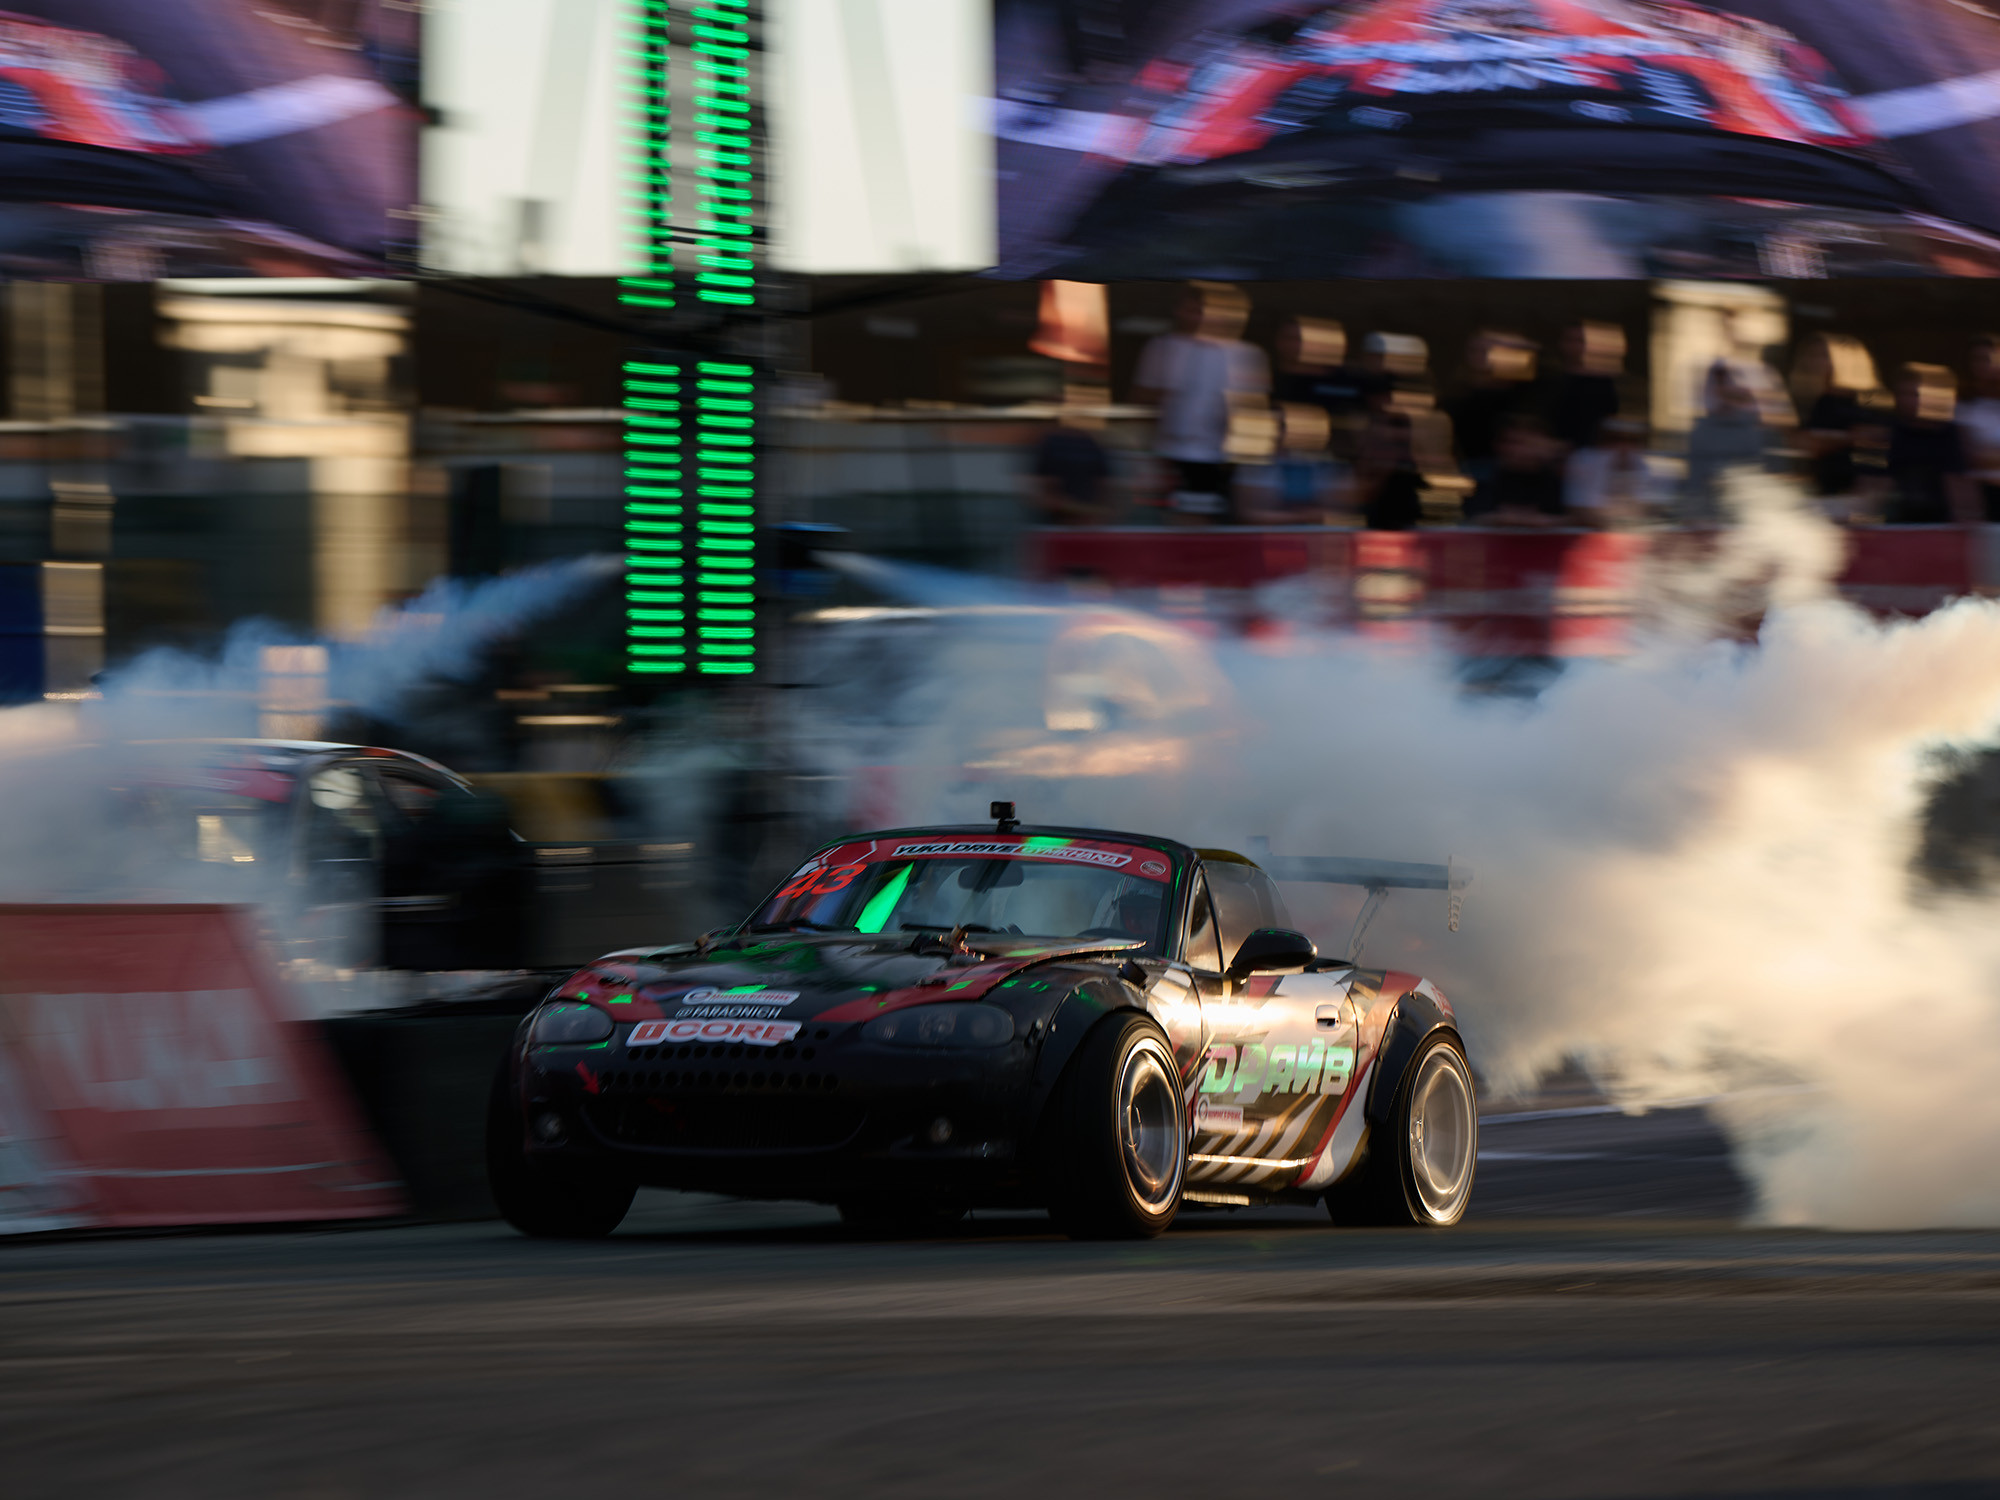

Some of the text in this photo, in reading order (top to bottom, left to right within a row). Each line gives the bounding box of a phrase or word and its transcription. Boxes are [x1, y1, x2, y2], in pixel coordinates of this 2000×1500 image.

[895, 844, 954, 856] YUKA
[950, 843, 1020, 855] DRIVE
[774, 863, 868, 899] 43
